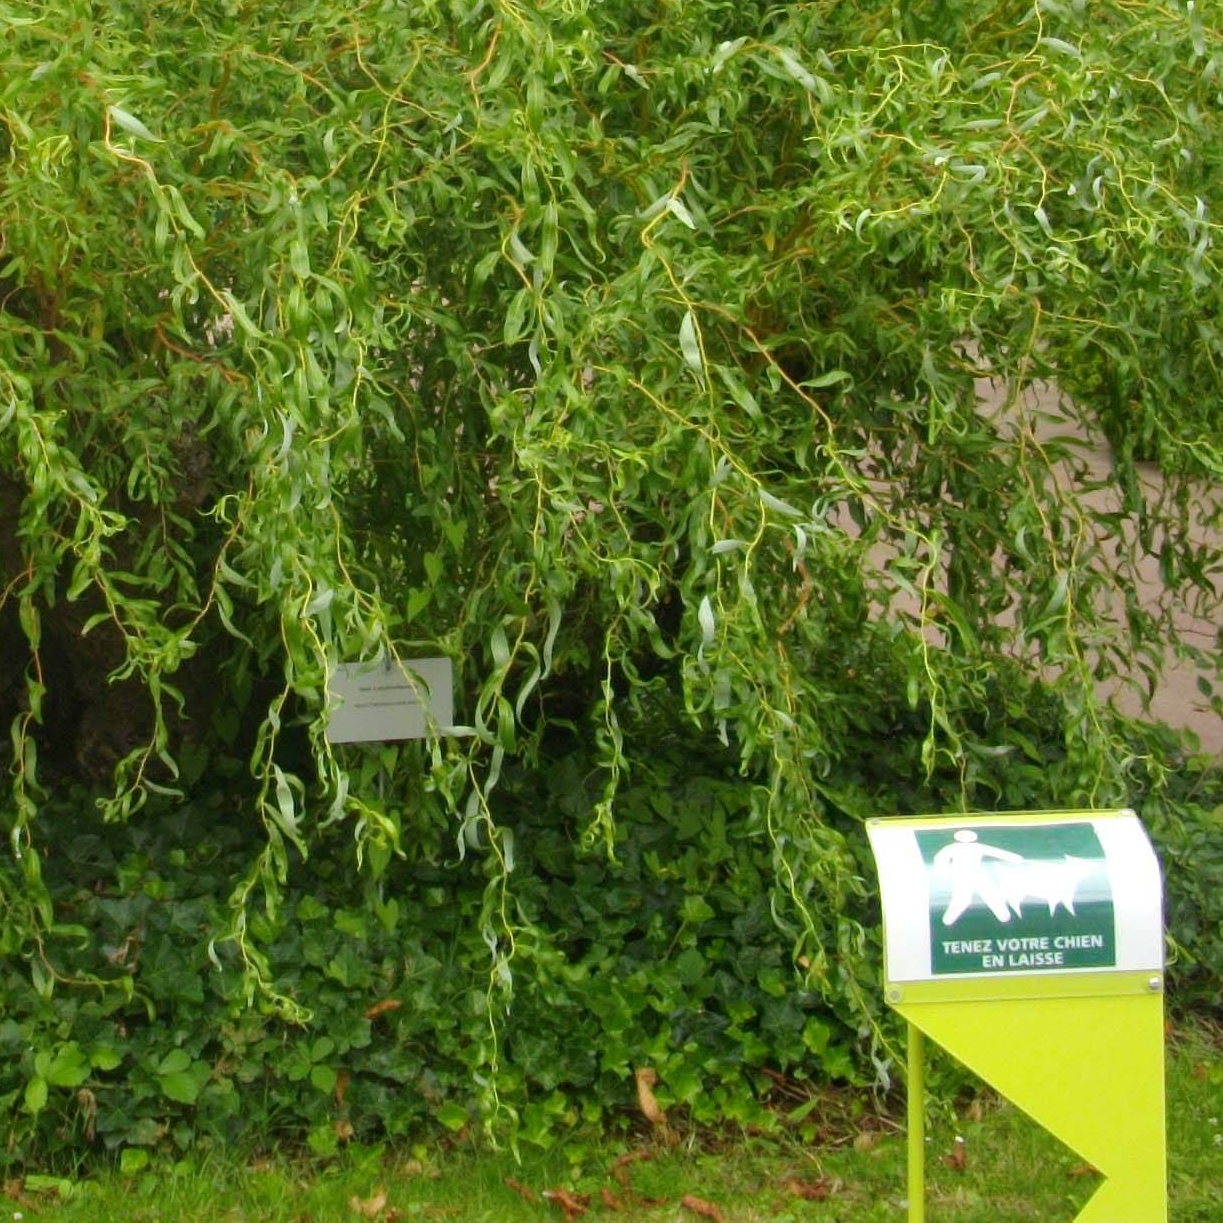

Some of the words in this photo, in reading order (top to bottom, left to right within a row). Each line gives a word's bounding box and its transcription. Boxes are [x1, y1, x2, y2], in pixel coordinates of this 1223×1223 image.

[942, 940, 992, 954] TENEZ
[996, 937, 1049, 952] VOTRE
[1054, 935, 1103, 949] CHIEN
[982, 955, 1004, 968] EN
[1009, 952, 1063, 967] LAISSE
